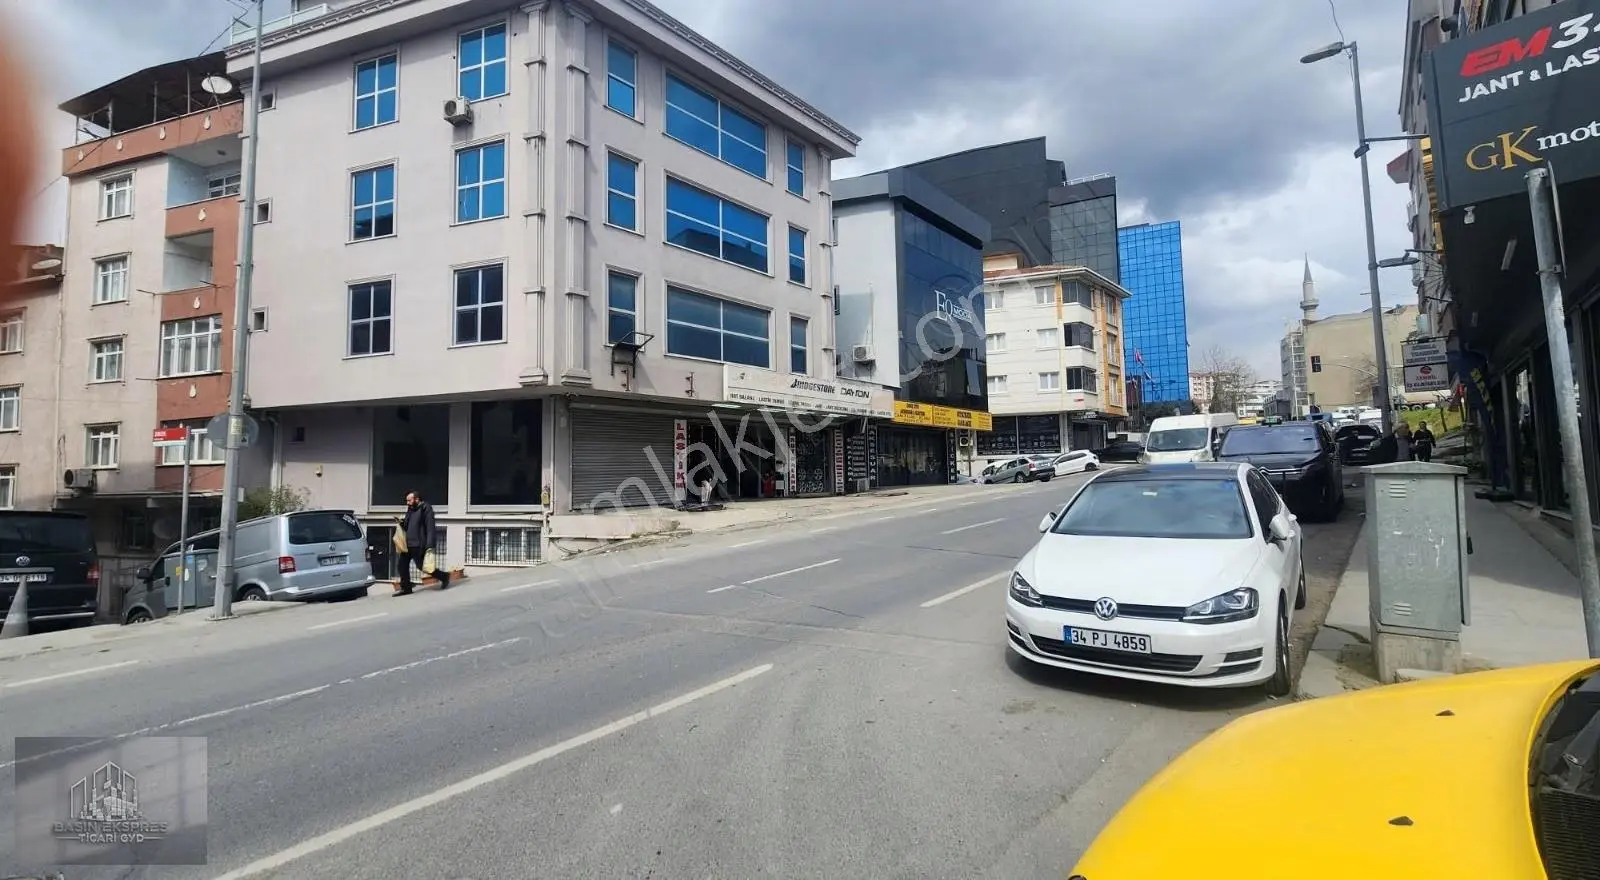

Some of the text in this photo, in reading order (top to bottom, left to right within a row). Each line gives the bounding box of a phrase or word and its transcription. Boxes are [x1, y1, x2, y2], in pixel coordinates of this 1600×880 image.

[1460, 13, 1600, 77] EM3
[1459, 47, 1600, 103] JANT & LAS
[1466, 126, 1543, 170] GK
[1072, 630, 1147, 651] 34 PJ 4859
